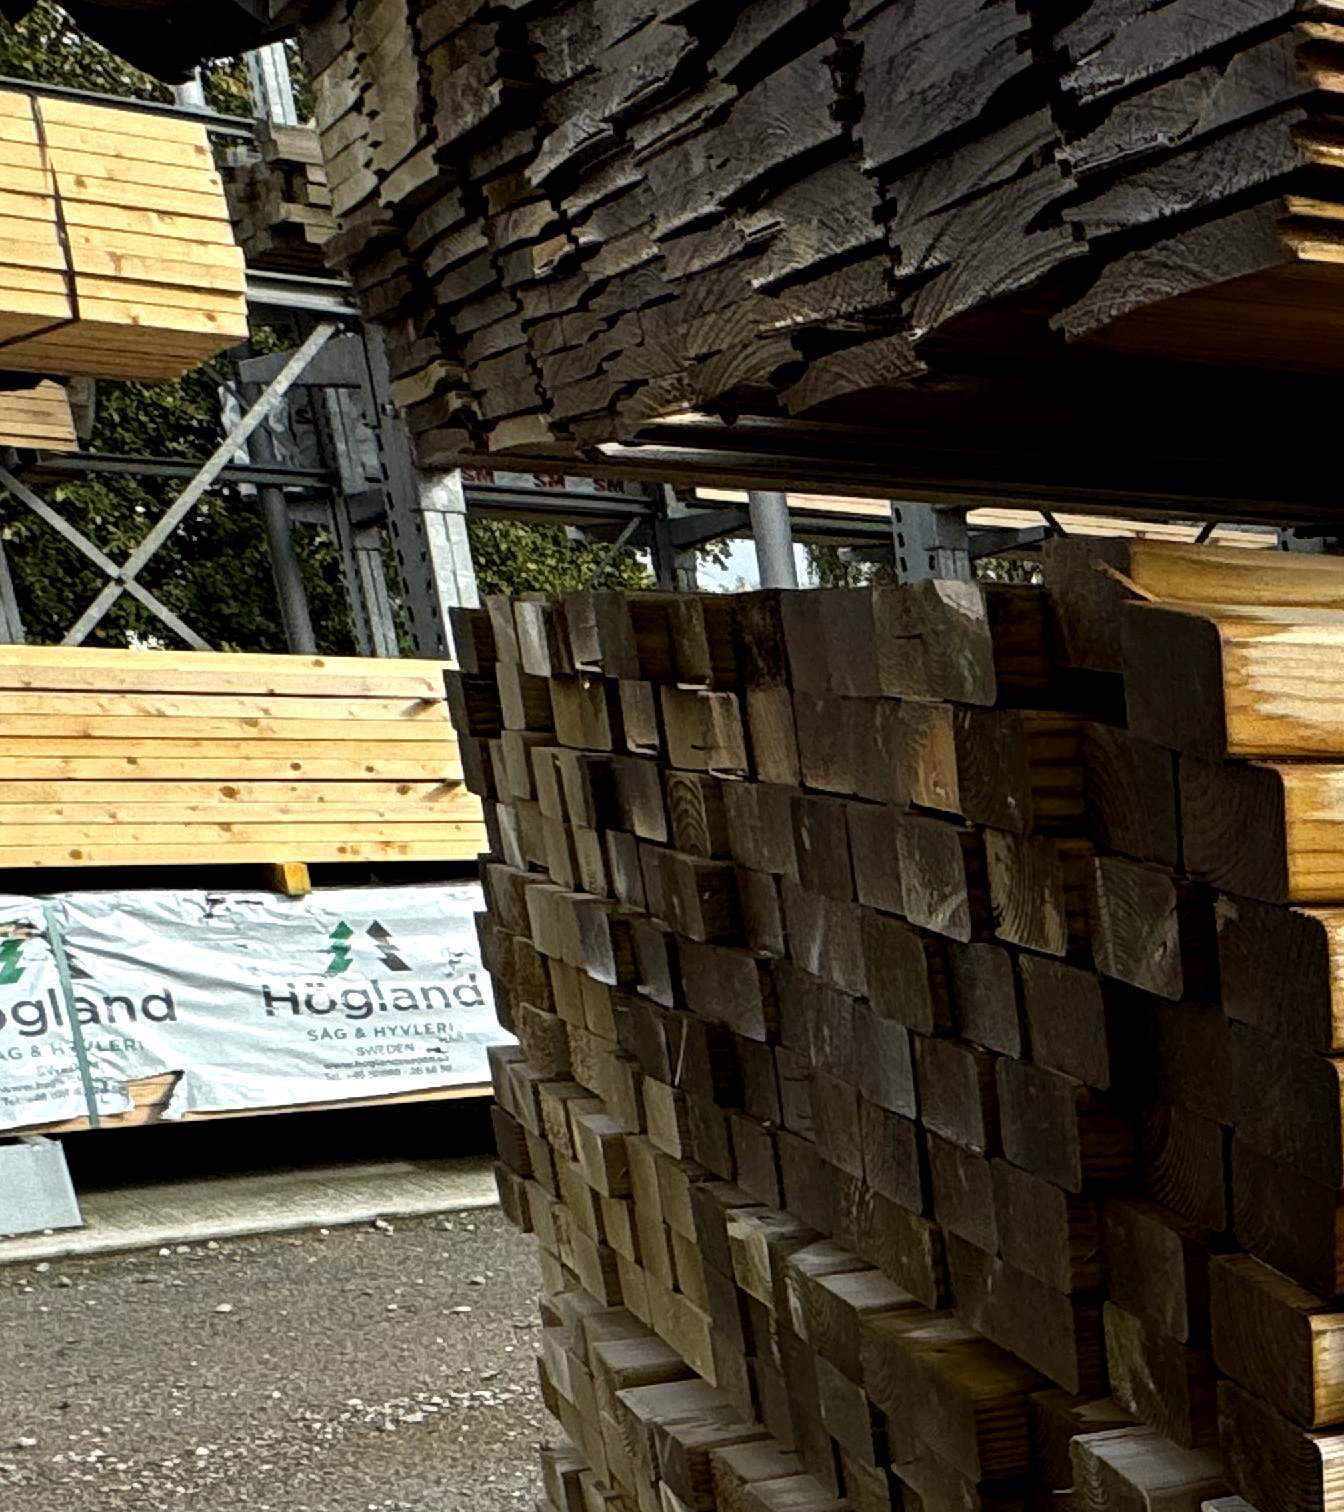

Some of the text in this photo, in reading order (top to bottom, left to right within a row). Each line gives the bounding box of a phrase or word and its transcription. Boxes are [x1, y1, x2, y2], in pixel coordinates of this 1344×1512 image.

[262, 974, 485, 1019] Högland
[0, 988, 177, 1037] gland
[354, 1027, 367, 1038] &
[374, 1022, 454, 1037] HYVLERI
[30, 1045, 42, 1058] &
